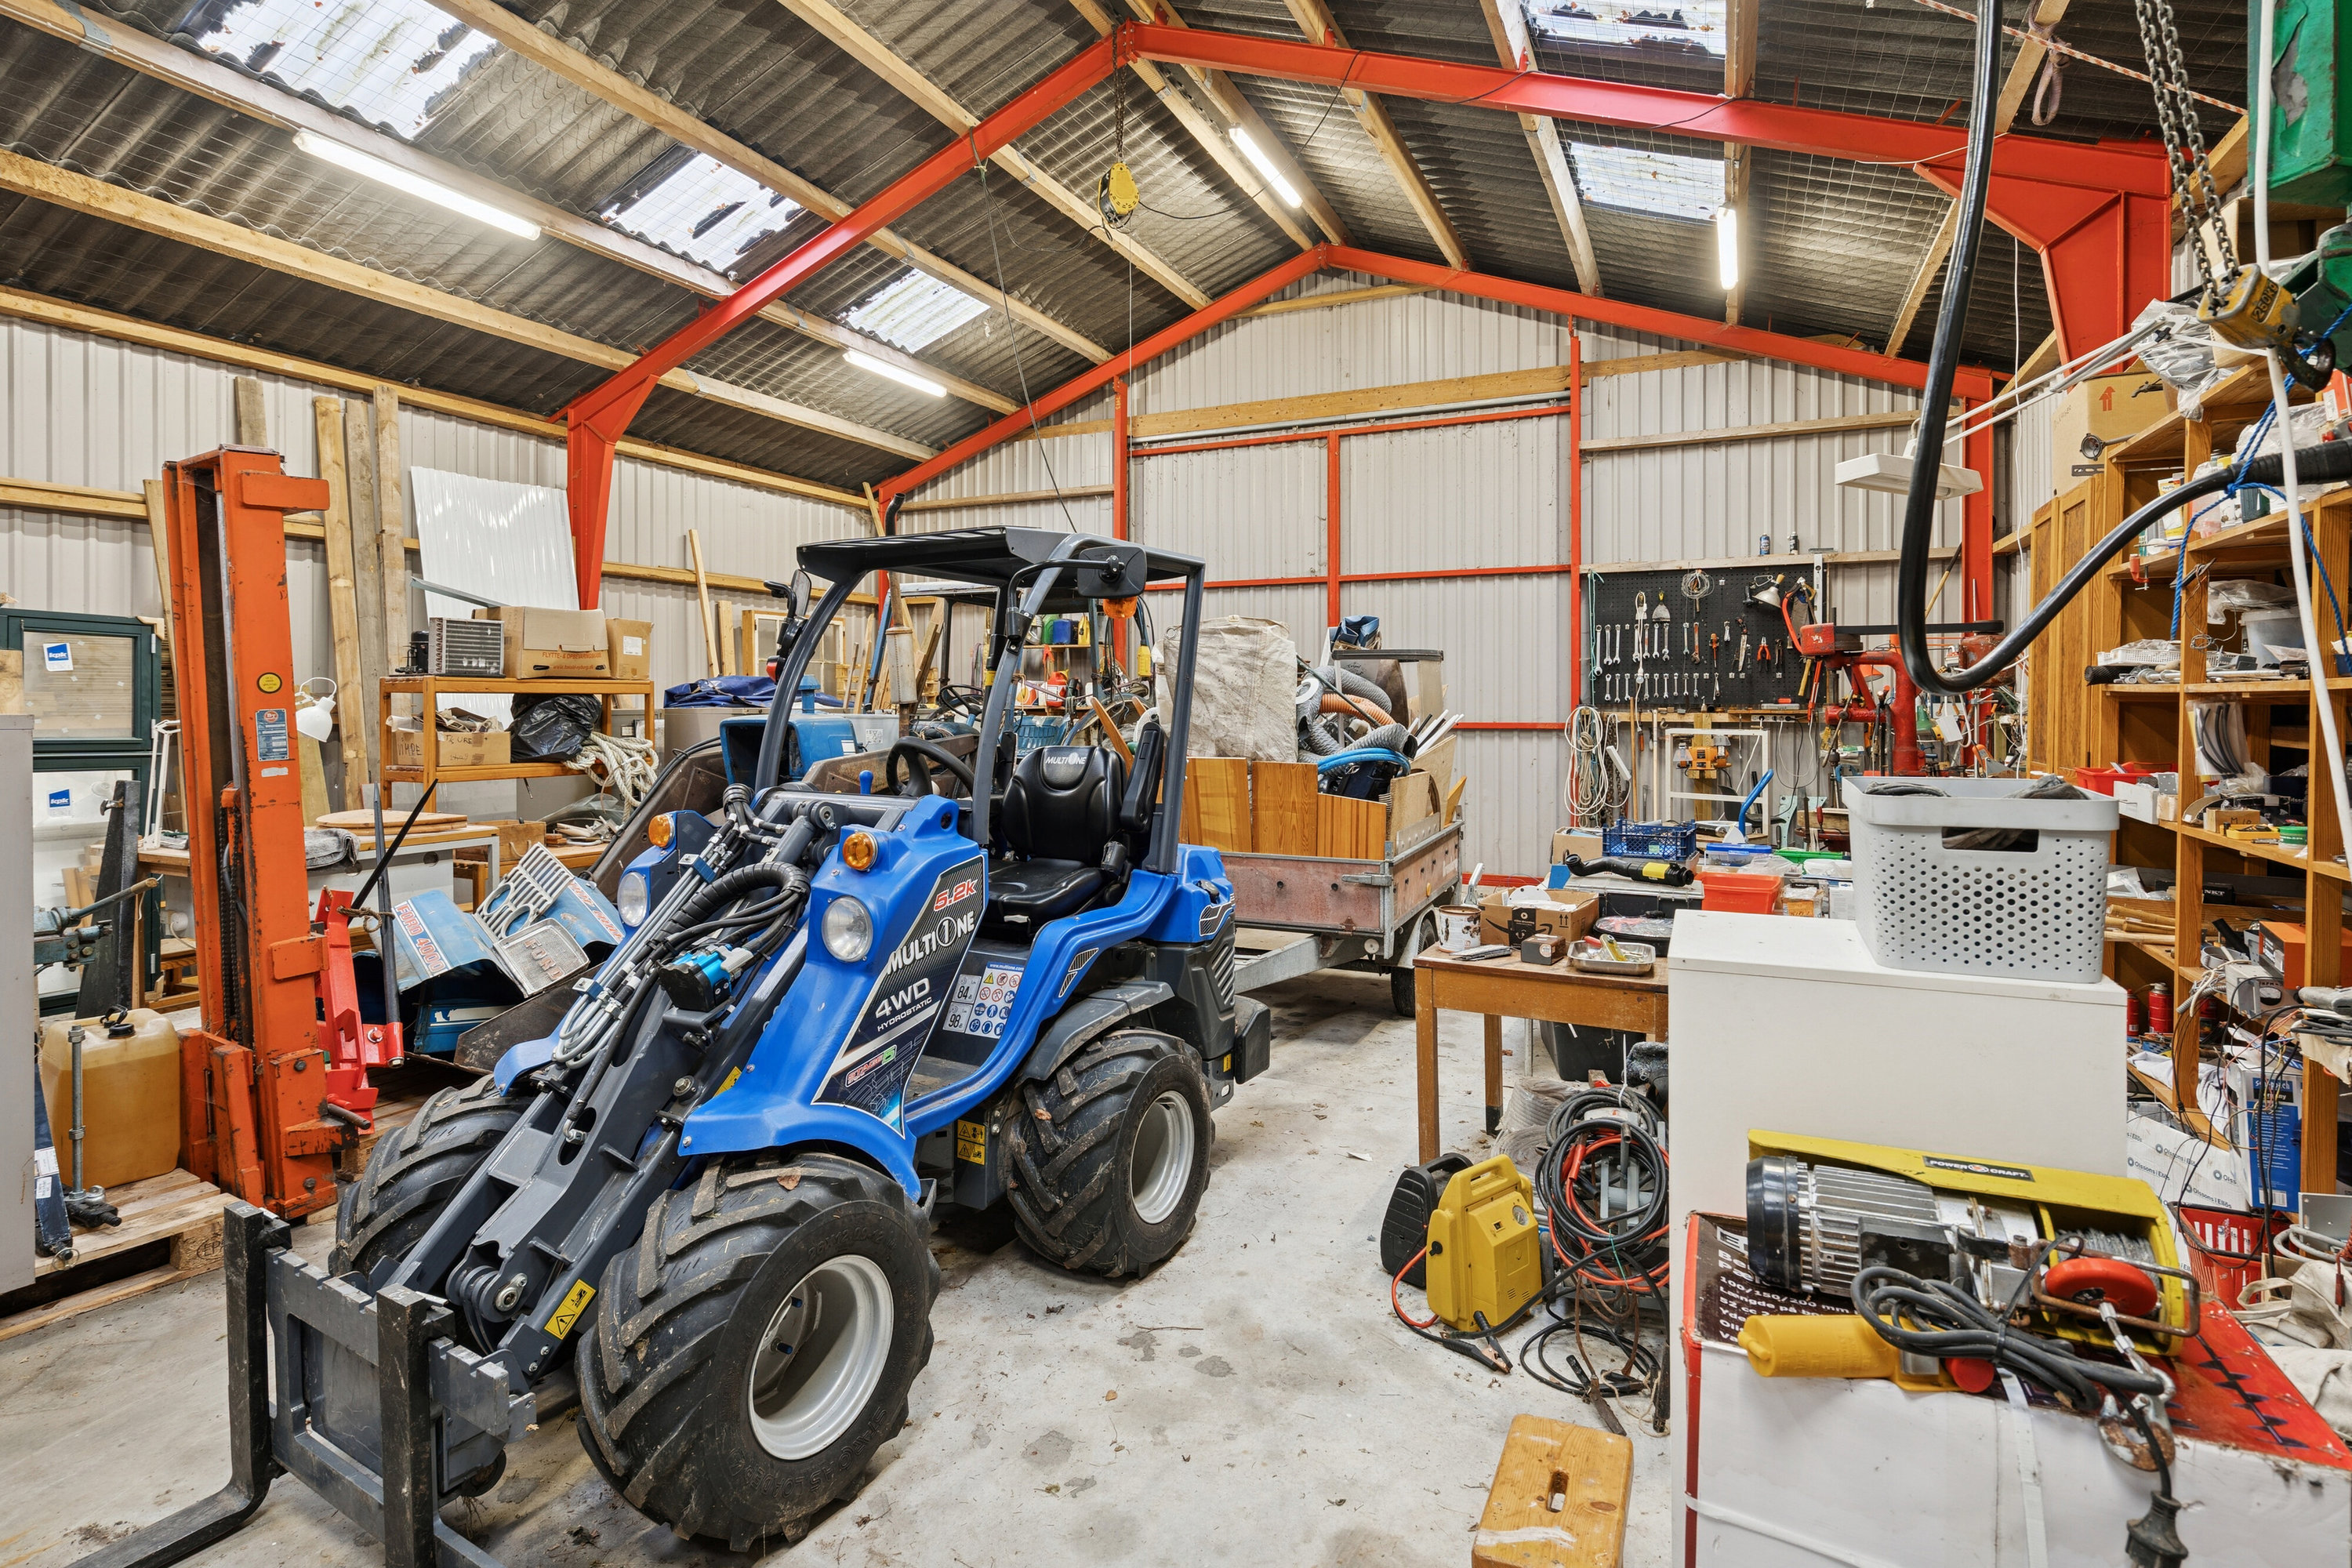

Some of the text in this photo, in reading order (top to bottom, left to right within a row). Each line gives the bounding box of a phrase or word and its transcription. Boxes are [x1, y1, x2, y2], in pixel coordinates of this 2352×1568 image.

[933, 878, 978, 912] 5.2k
[395, 904, 447, 973] FORD 4000
[524, 939, 565, 981] FORD
[875, 978, 931, 1019] 4WD
[957, 985, 970, 1000] 84
[877, 996, 932, 1033] HYDROSTATIC
[948, 1014, 961, 1028] 98
[881, 1047, 895, 1065] 5
[1929, 1160, 2027, 1178] POWER CRAFT
[2134, 1160, 2156, 1175] Olssons
[2193, 1187, 2215, 1203] Olssons
[1719, 1276, 1849, 1315] 100/150/200 mm
[1719, 1285, 1776, 1309] Længde
[1779, 1304, 1798, 1314] på
[1719, 1296, 1738, 1309] 52
[1740, 1306, 1757, 1315] cc
